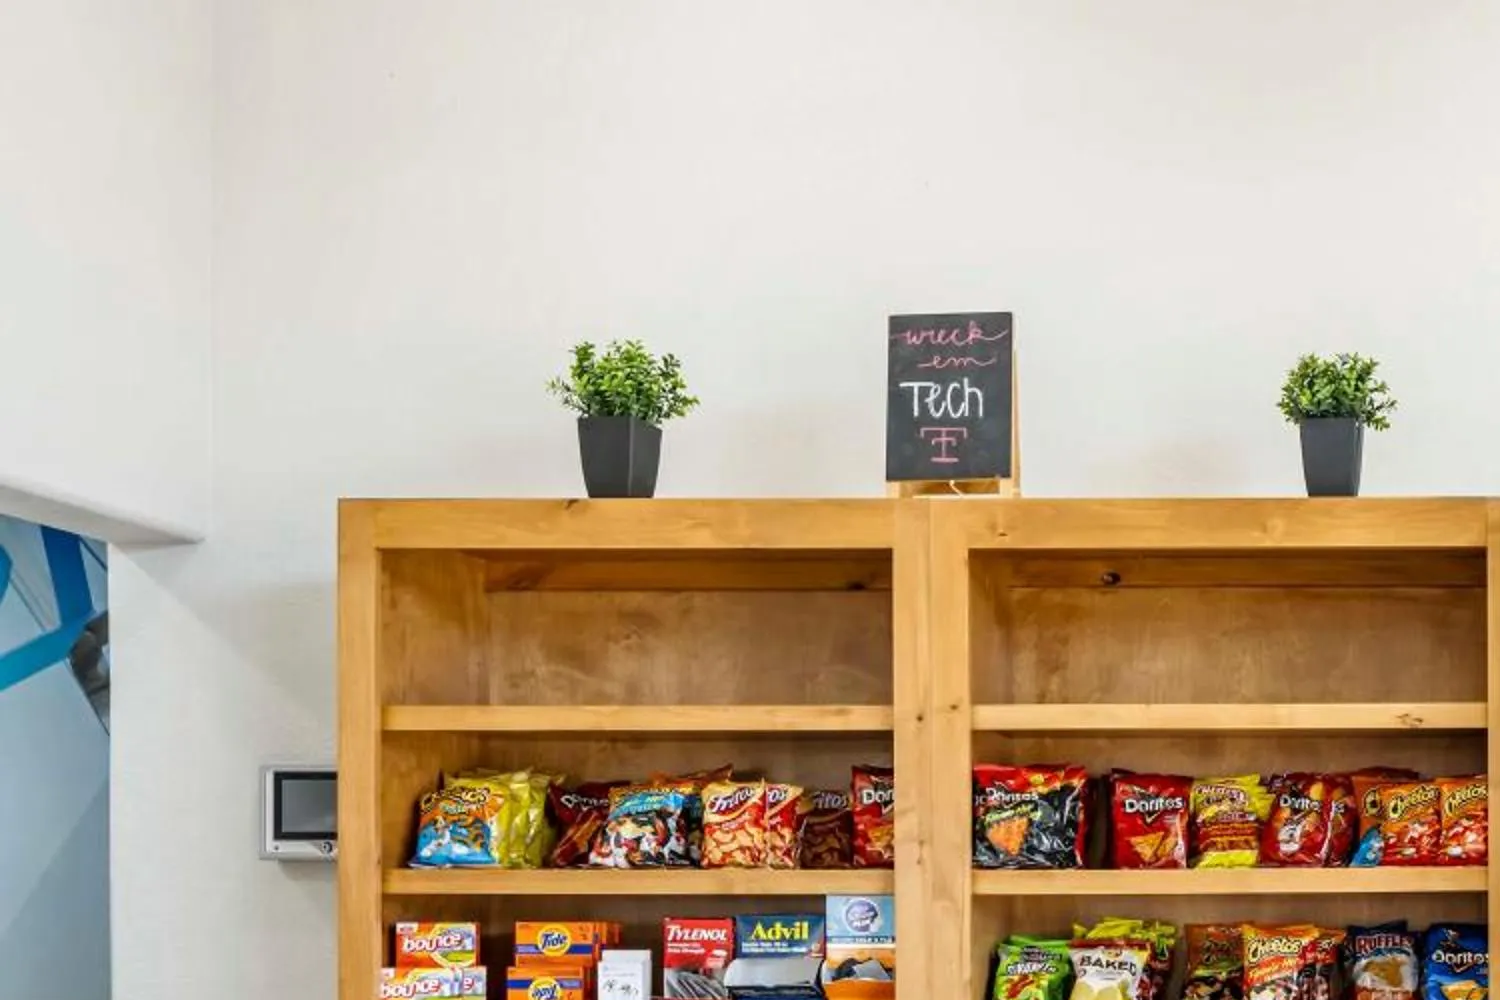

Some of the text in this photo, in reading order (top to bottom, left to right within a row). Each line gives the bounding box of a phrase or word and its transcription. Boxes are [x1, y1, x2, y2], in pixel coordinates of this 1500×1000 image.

[890, 320, 1009, 346] wreck
[899, 377, 984, 419] Tech
[1125, 795, 1184, 814] Doritos
[751, 921, 809, 940] Advil
[402, 933, 462, 954] bounce
[1079, 955, 1137, 976] BAKED
[380, 978, 440, 1000] bounce
